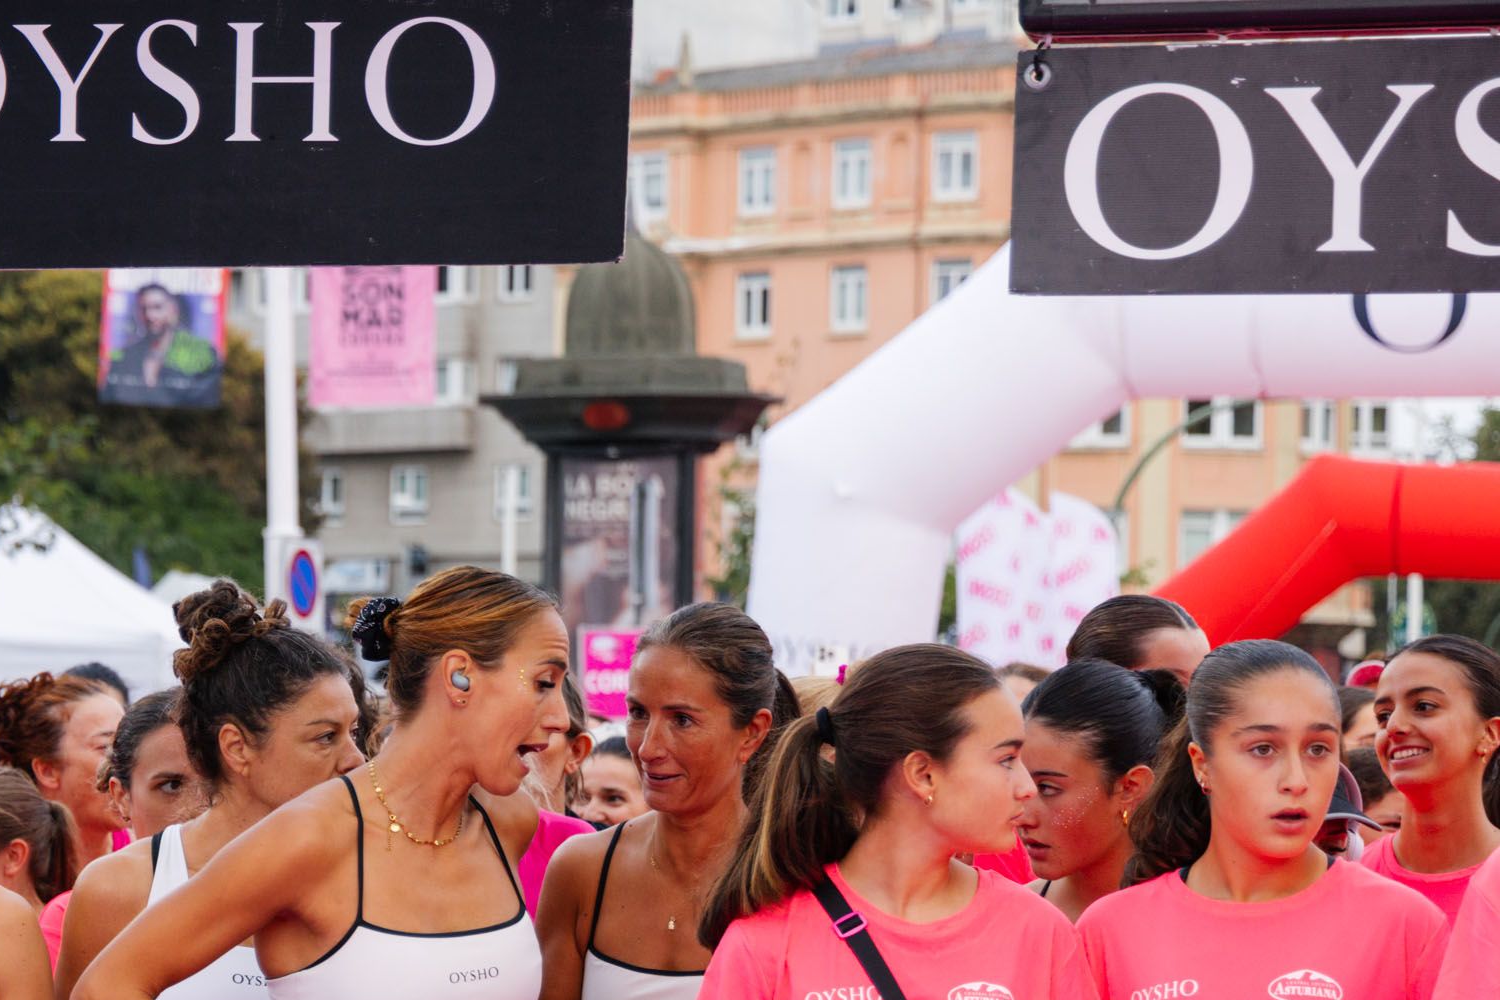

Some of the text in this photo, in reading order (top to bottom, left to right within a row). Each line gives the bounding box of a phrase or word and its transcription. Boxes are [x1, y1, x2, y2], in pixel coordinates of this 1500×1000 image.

[232, 974, 268, 987] OYS
[449, 966, 500, 985] OYSHO
[1274, 982, 1338, 1000] ASTURIANA
